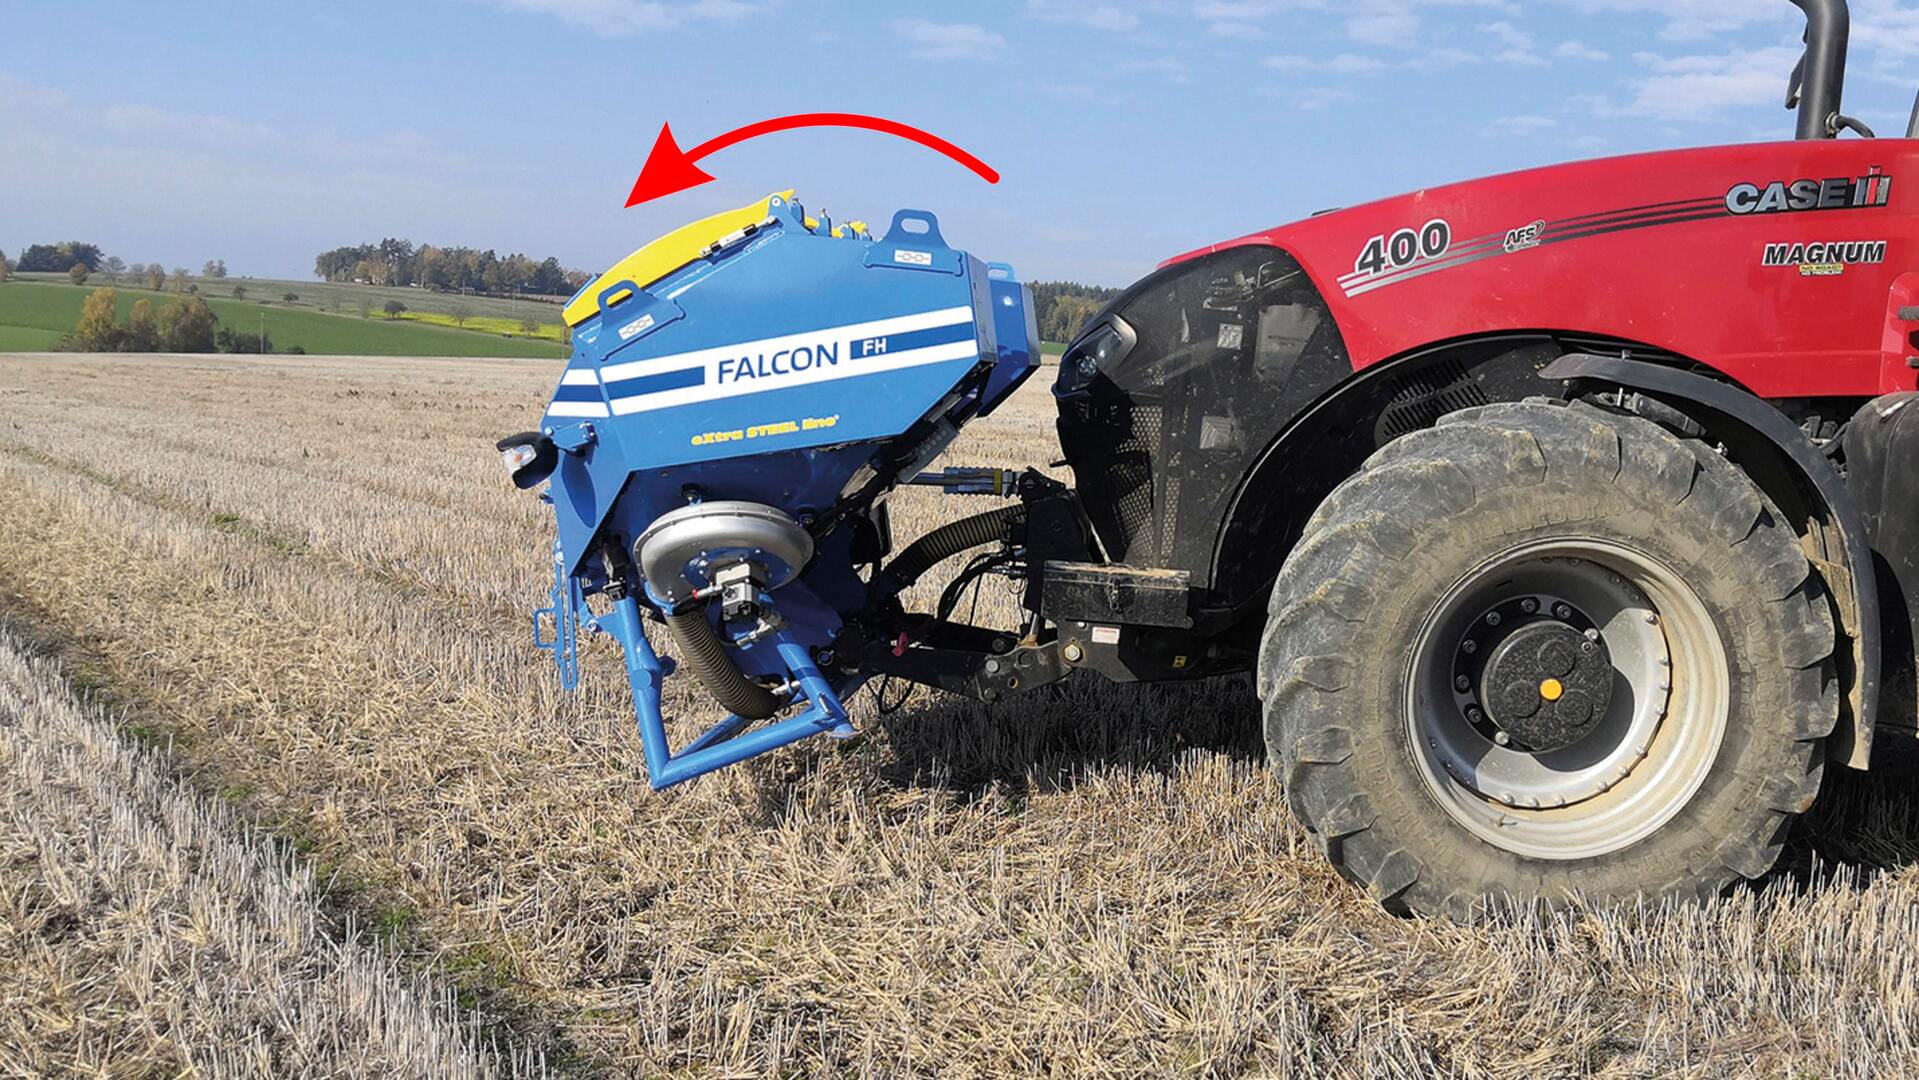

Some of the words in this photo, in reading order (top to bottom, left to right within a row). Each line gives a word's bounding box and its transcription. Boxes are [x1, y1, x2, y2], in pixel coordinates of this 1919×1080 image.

[1726, 178, 1850, 214] CASE
[1356, 219, 1450, 275] 400
[1504, 225, 1536, 246] AFS
[1762, 241, 1886, 265] MAGNUM
[718, 342, 838, 384] FALCON
[862, 337, 887, 355] FH
[691, 430, 743, 445] eXtra
[746, 421, 799, 438] STEEL
